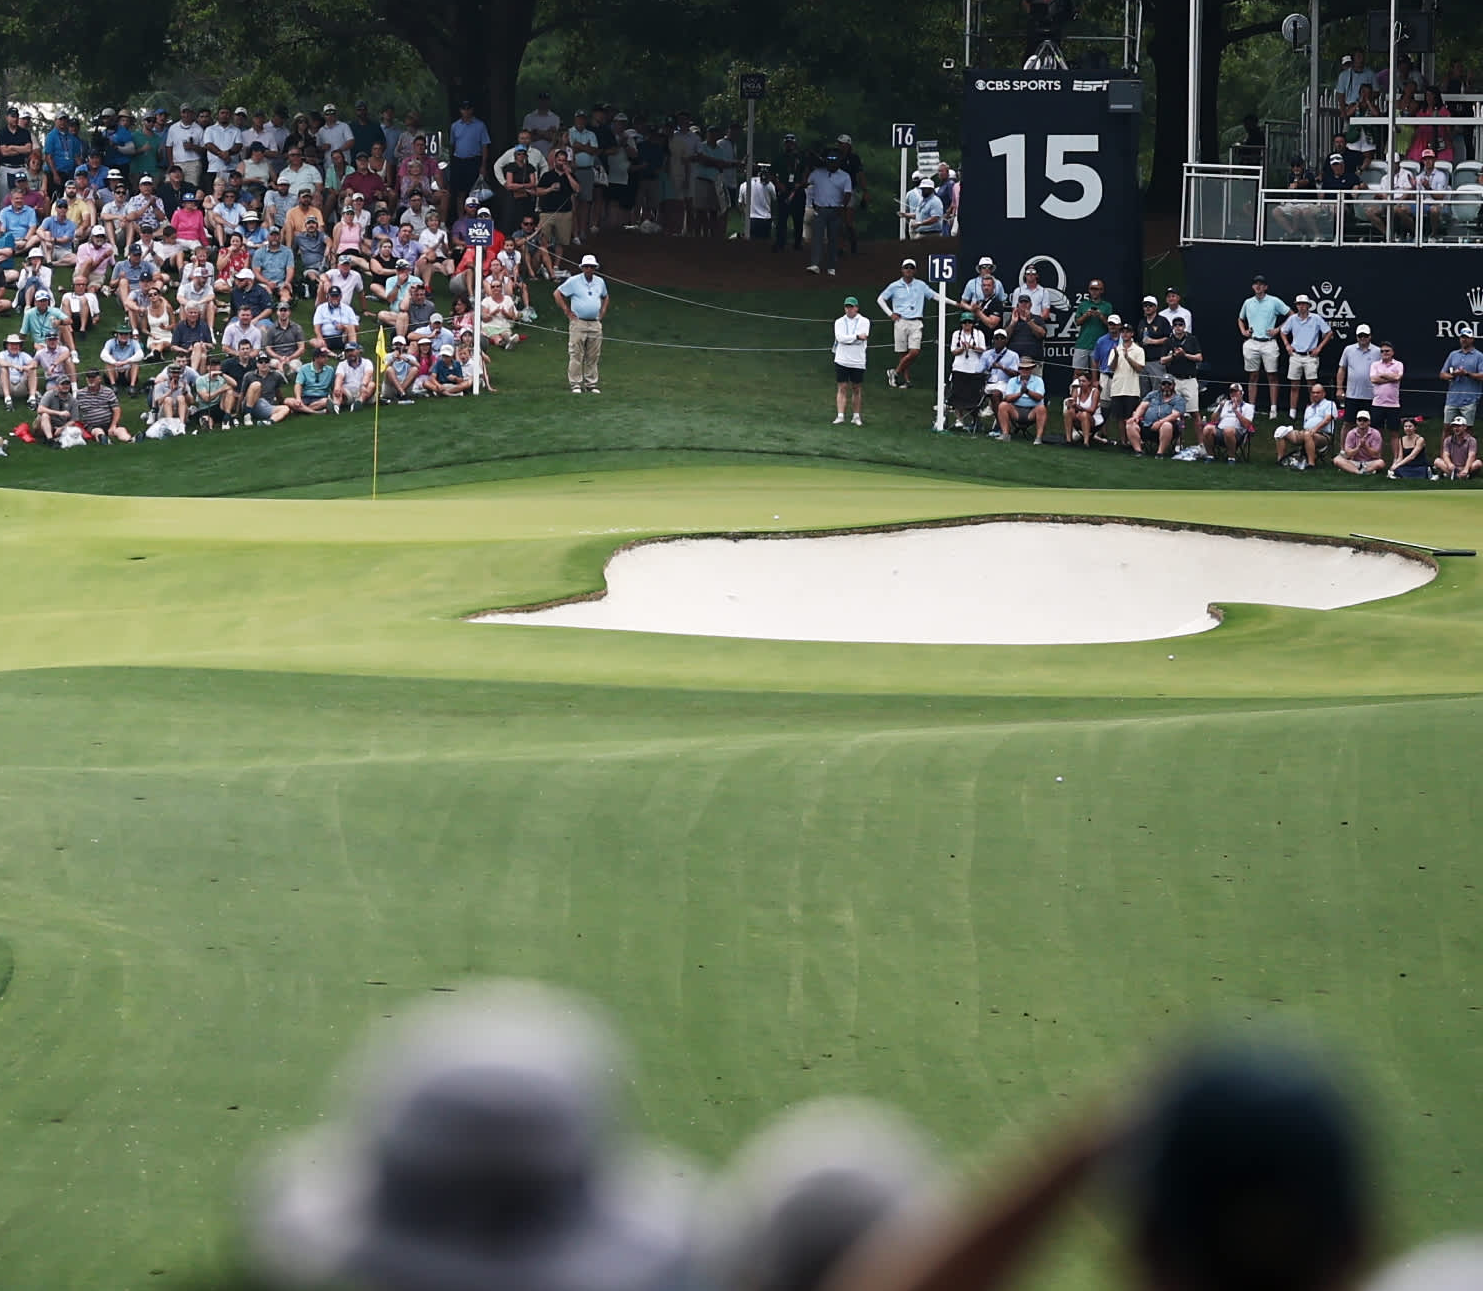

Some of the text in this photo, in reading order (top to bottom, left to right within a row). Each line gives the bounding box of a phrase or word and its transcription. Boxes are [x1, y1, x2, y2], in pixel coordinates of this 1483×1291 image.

[986, 80, 1062, 91] CBS SPORTS
[896, 127, 914, 146] 16
[988, 133, 1103, 220] 15
[468, 228, 491, 236] PGA
[932, 258, 953, 279] 15
[1043, 347, 1075, 358] OLLO
